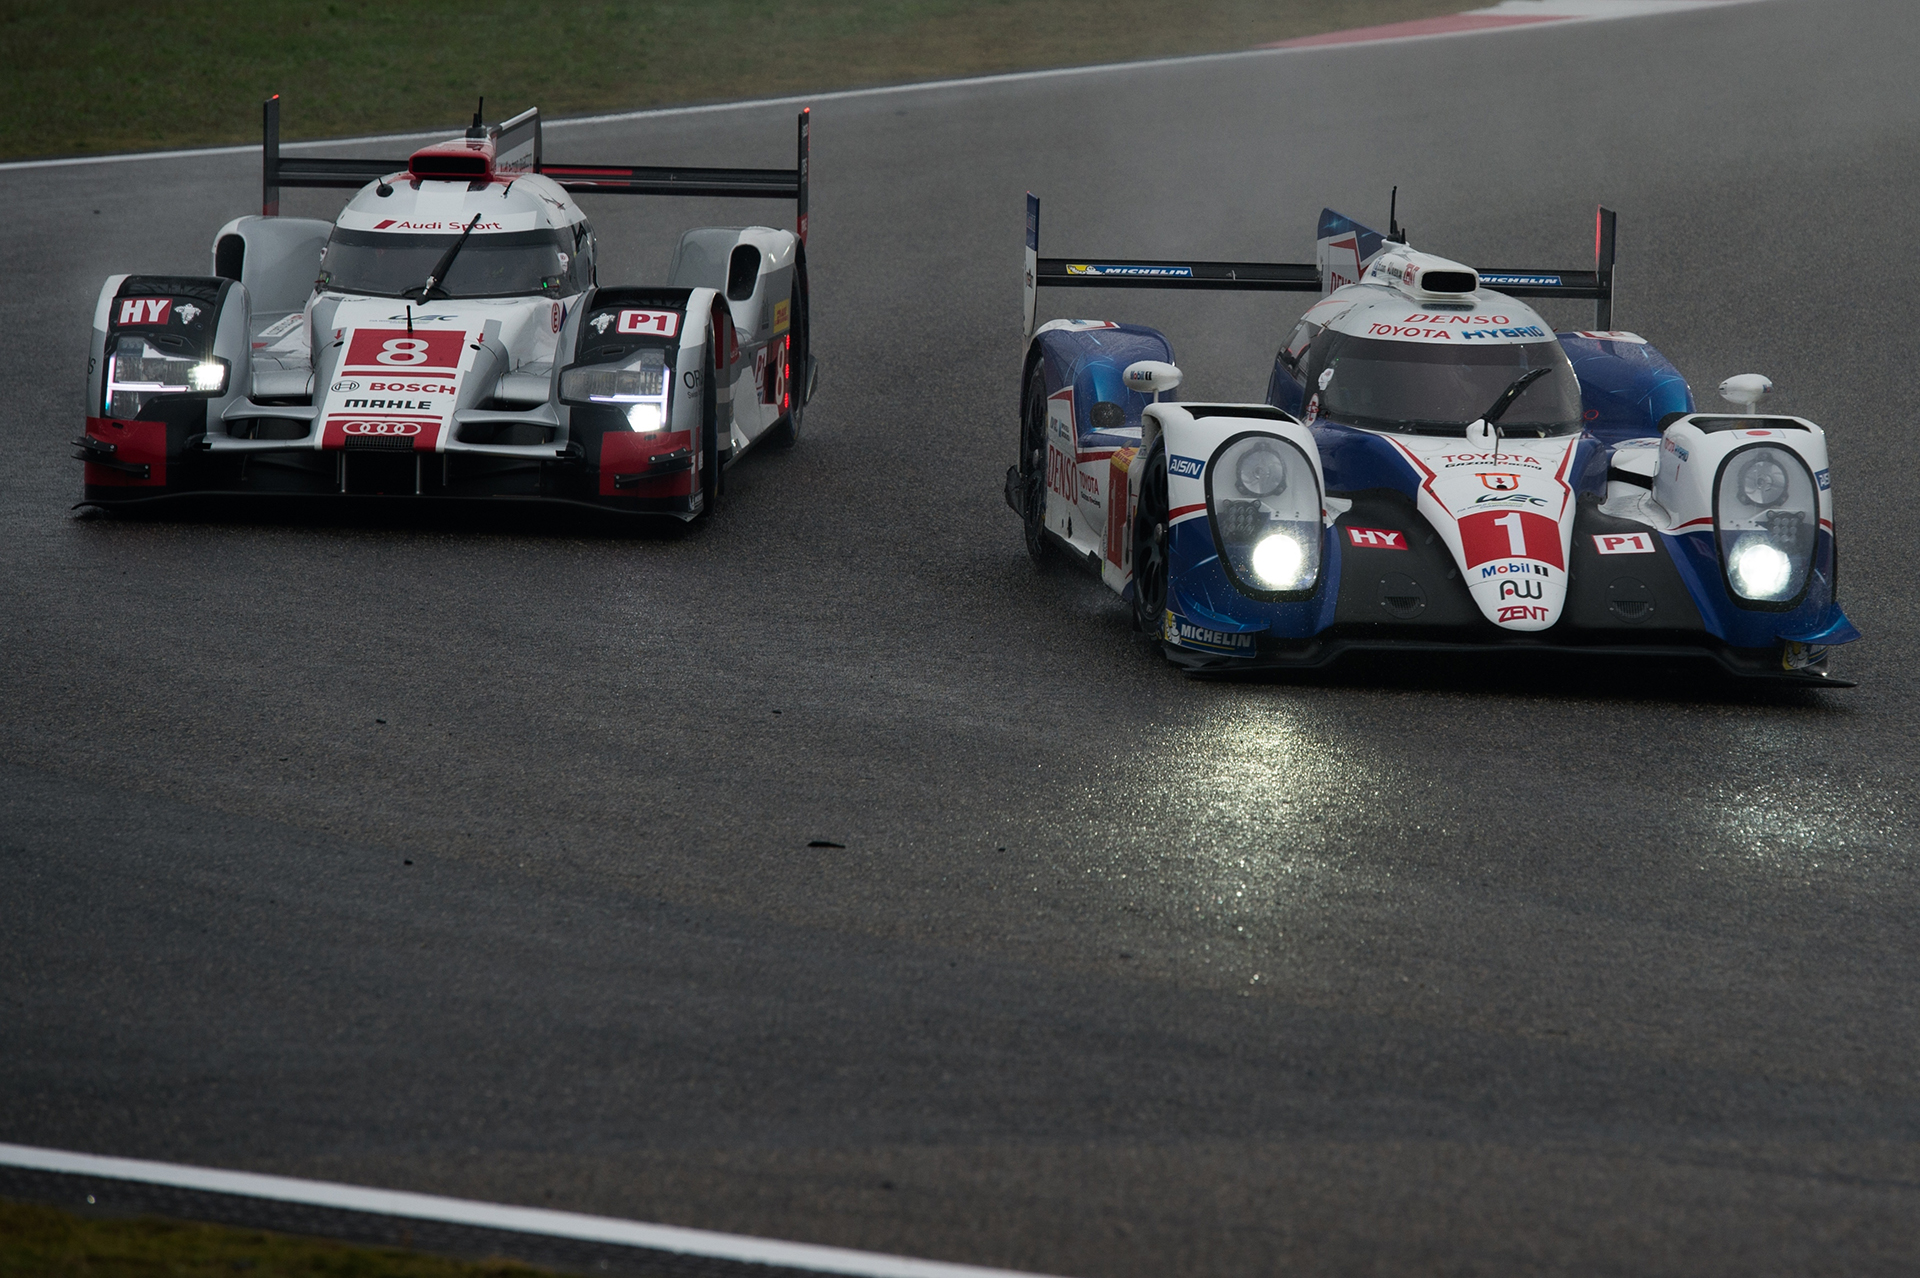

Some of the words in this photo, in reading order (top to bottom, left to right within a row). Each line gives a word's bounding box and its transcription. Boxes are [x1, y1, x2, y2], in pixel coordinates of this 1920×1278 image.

[397, 221, 442, 230] Audi
[449, 221, 503, 232] Sport
[1105, 267, 1189, 276] MICHELIN
[119, 299, 169, 324] HY
[1404, 313, 1510, 325] DENSO
[628, 313, 668, 332] P1
[1368, 323, 1451, 339] TOYOTA
[1461, 325, 1546, 340] HYBRID
[376, 338, 430, 366] 8
[775, 341, 785, 406] 8
[369, 382, 456, 395] BOSCH
[344, 399, 432, 410] MAHLE
[1169, 458, 1202, 476] AISIN
[1441, 453, 1541, 465] TOYOTA
[1047, 444, 1078, 506] DENSO
[1079, 470, 1100, 496] TOYOTA
[1475, 494, 1548, 507] WEC
[1350, 529, 1399, 546] HY
[1493, 512, 1528, 556] 1
[1602, 536, 1645, 551] P1
[1482, 563, 1530, 578] Mobil
[1534, 565, 1549, 577] 1
[1497, 606, 1549, 623] ZENT
[1181, 624, 1252, 648] MICHELIN
